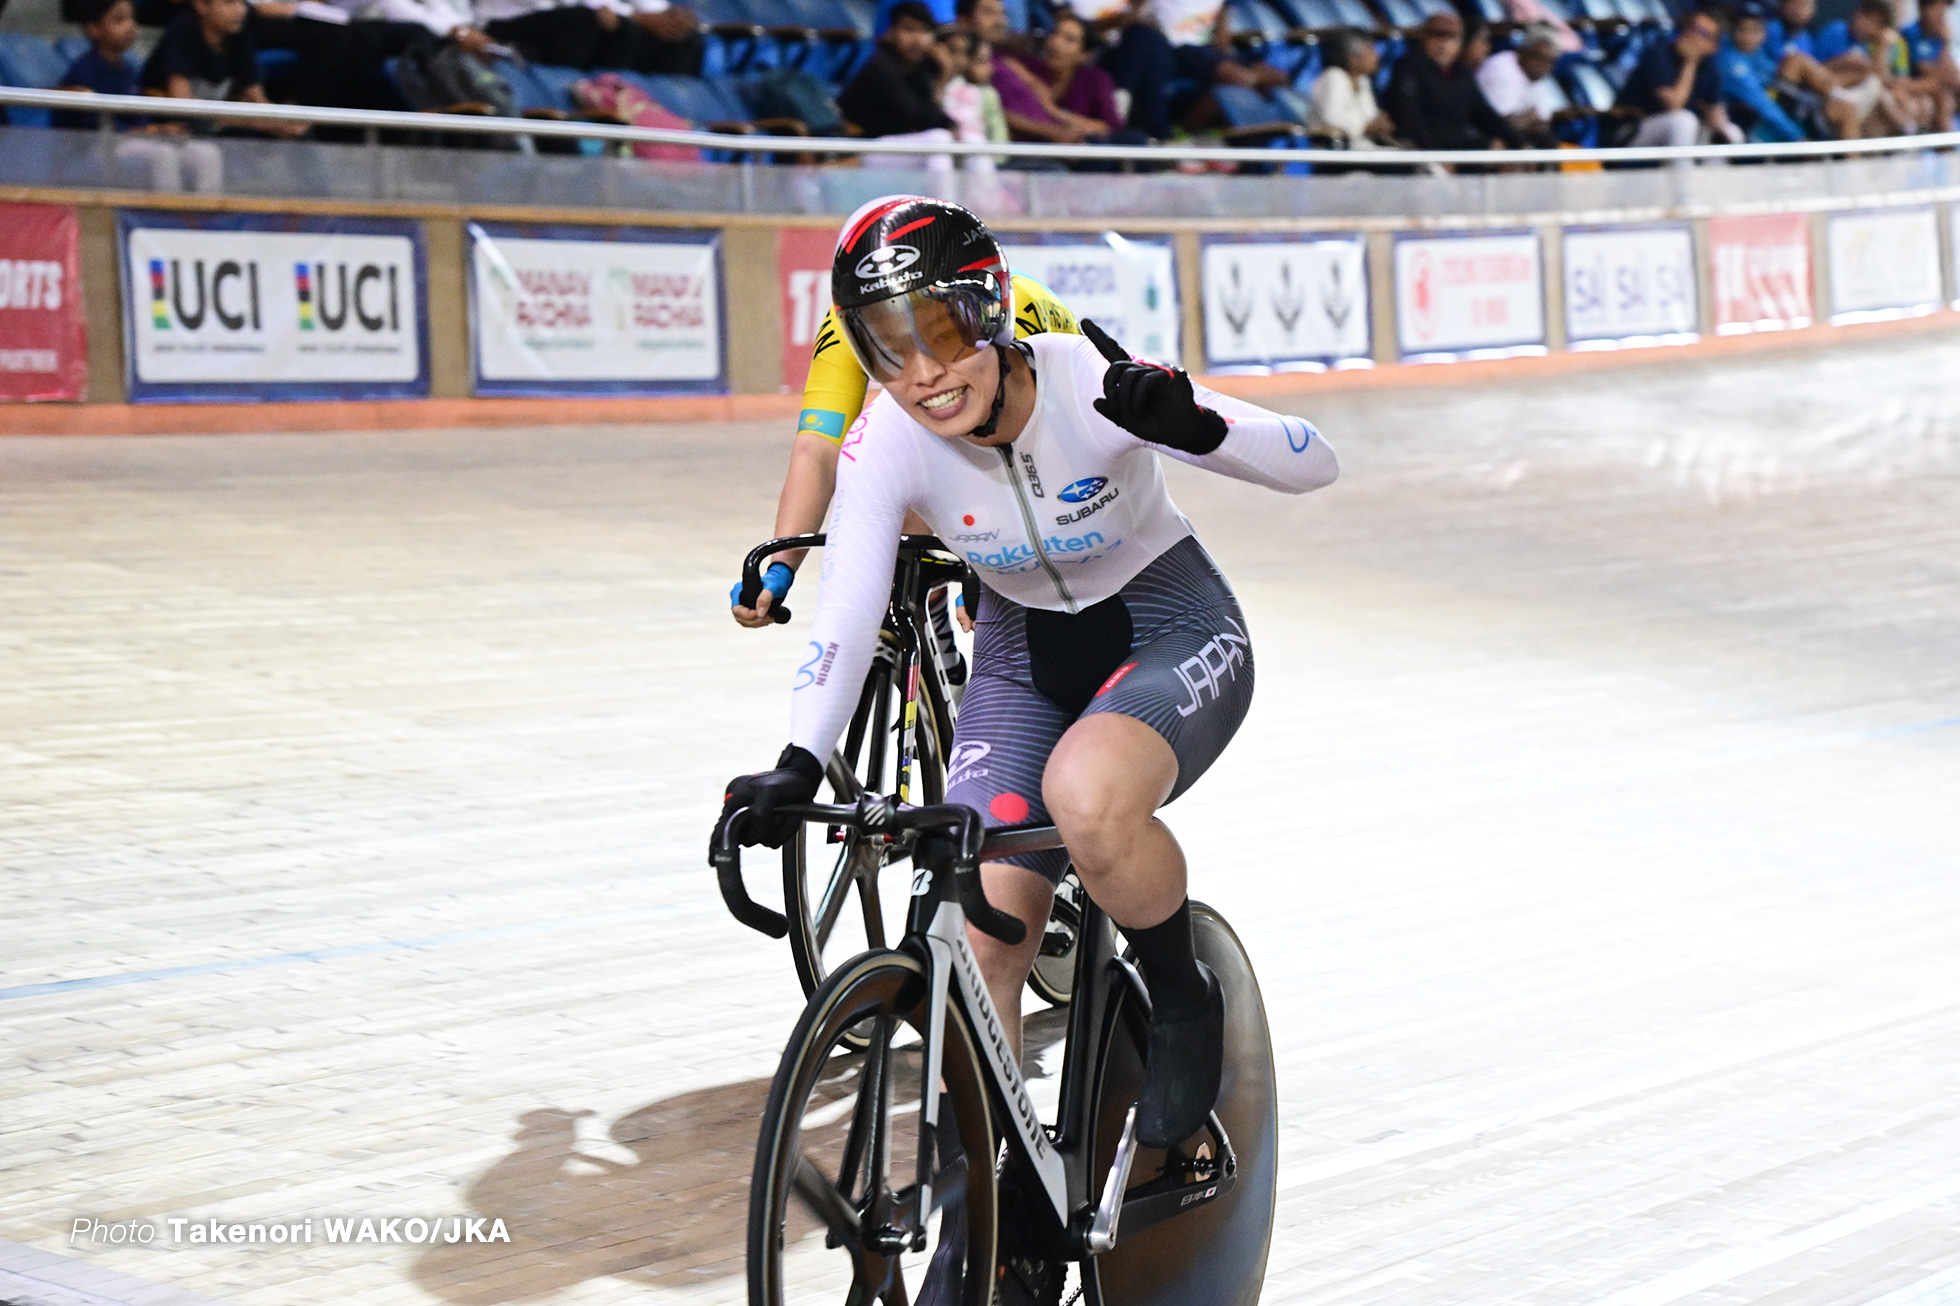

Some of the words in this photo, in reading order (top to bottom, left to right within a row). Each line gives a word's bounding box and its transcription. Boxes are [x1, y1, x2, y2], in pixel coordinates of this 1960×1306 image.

[171, 259, 263, 331] UCI
[316, 263, 401, 332] UCI
[860, 271, 924, 295] Kabuto
[1055, 487, 1120, 526] SUBARU
[948, 528, 1001, 544] JAPAN
[966, 531, 1105, 568] Rakuten
[815, 642, 840, 687] KEIRIN
[1172, 615, 1248, 718] JAPAN
